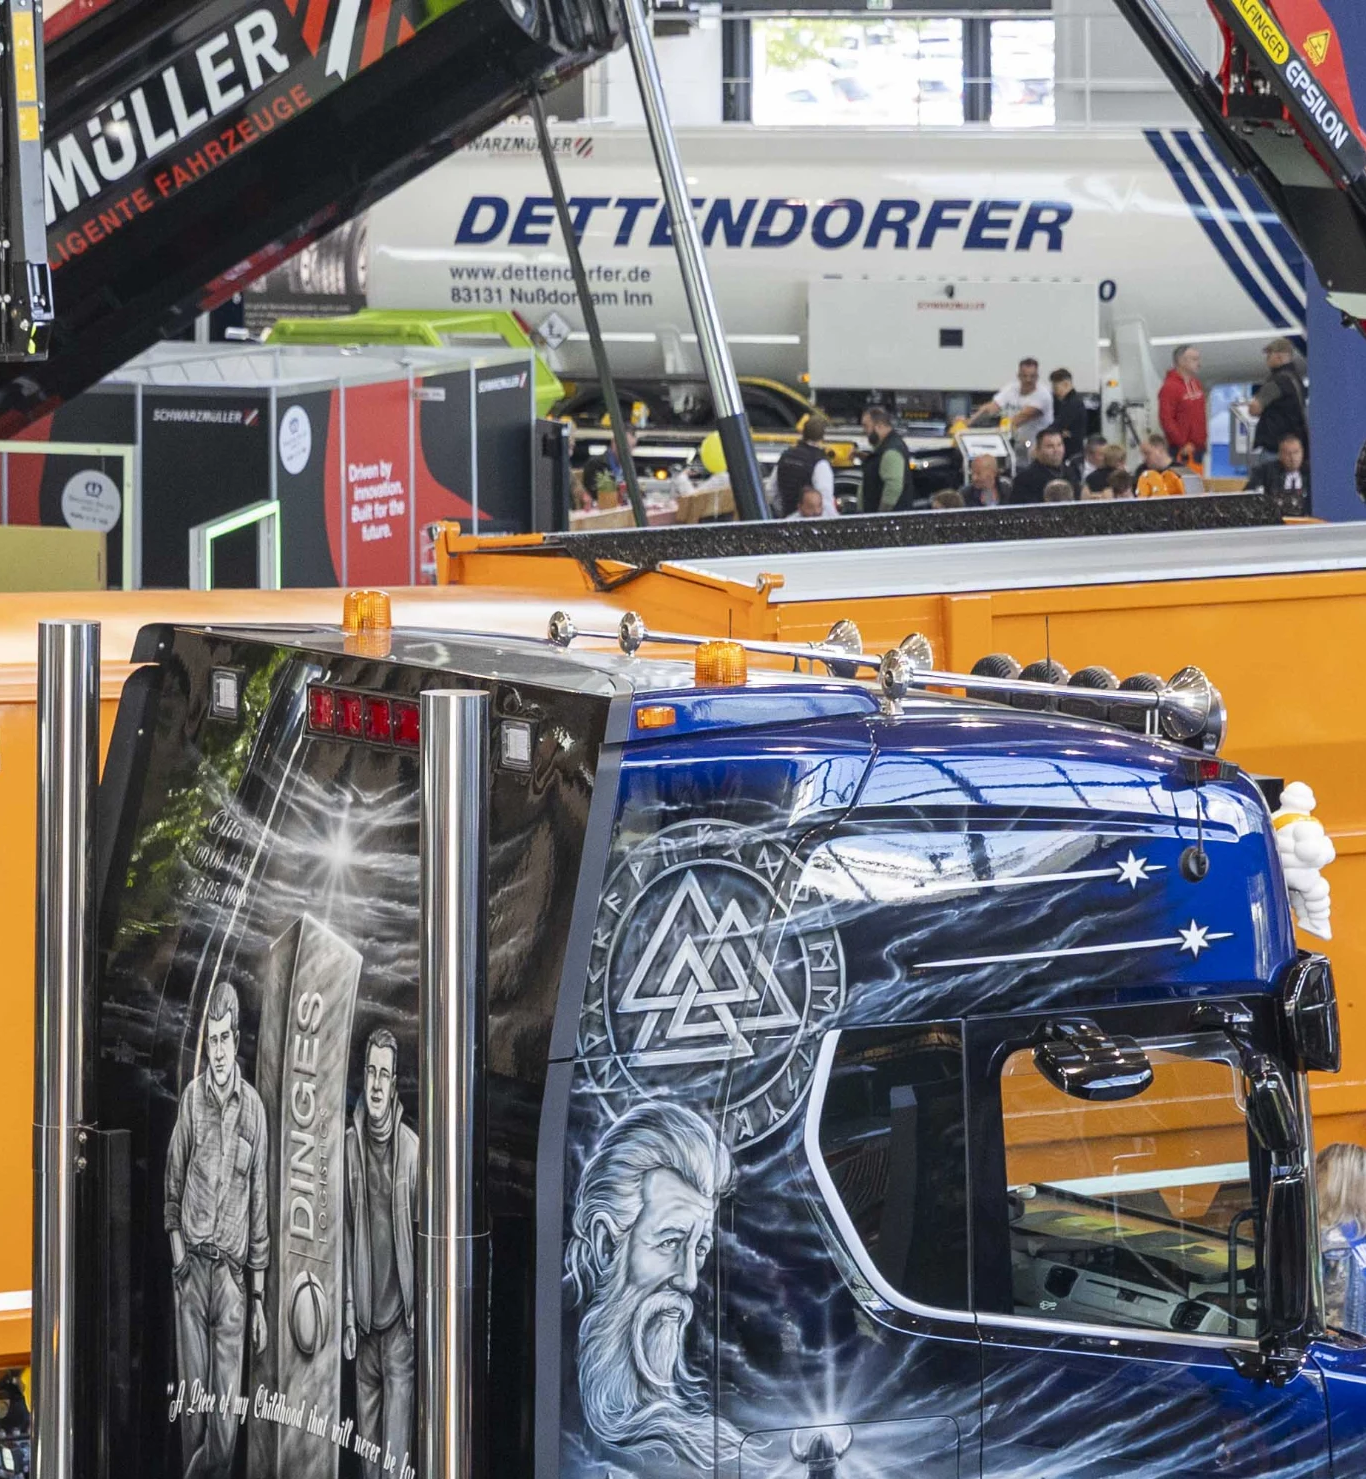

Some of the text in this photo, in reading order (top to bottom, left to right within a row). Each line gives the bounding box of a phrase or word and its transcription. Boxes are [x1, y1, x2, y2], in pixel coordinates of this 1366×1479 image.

[154, 84, 313, 197] FAHRZEUGE
[1286, 60, 1349, 149] EPSILON
[455, 195, 1074, 252] DETTENDORFER
[451, 287, 508, 304] 83131
[510, 287, 584, 306] Nußdor
[624, 289, 653, 306] Inn
[348, 459, 393, 483] Driven by
[290, 991, 324, 1242] DINGES
[317, 1107, 329, 1245] LOGISTICS
[187, 1378, 215, 1416] Piece
[219, 1384, 233, 1420] of
[234, 1391, 249, 1425] my
[253, 1384, 306, 1429] Childhood
[306, 1404, 329, 1438] that
[331, 1416, 354, 1449] will
[354, 1431, 381, 1464] never
[383, 1440, 397, 1474] be
